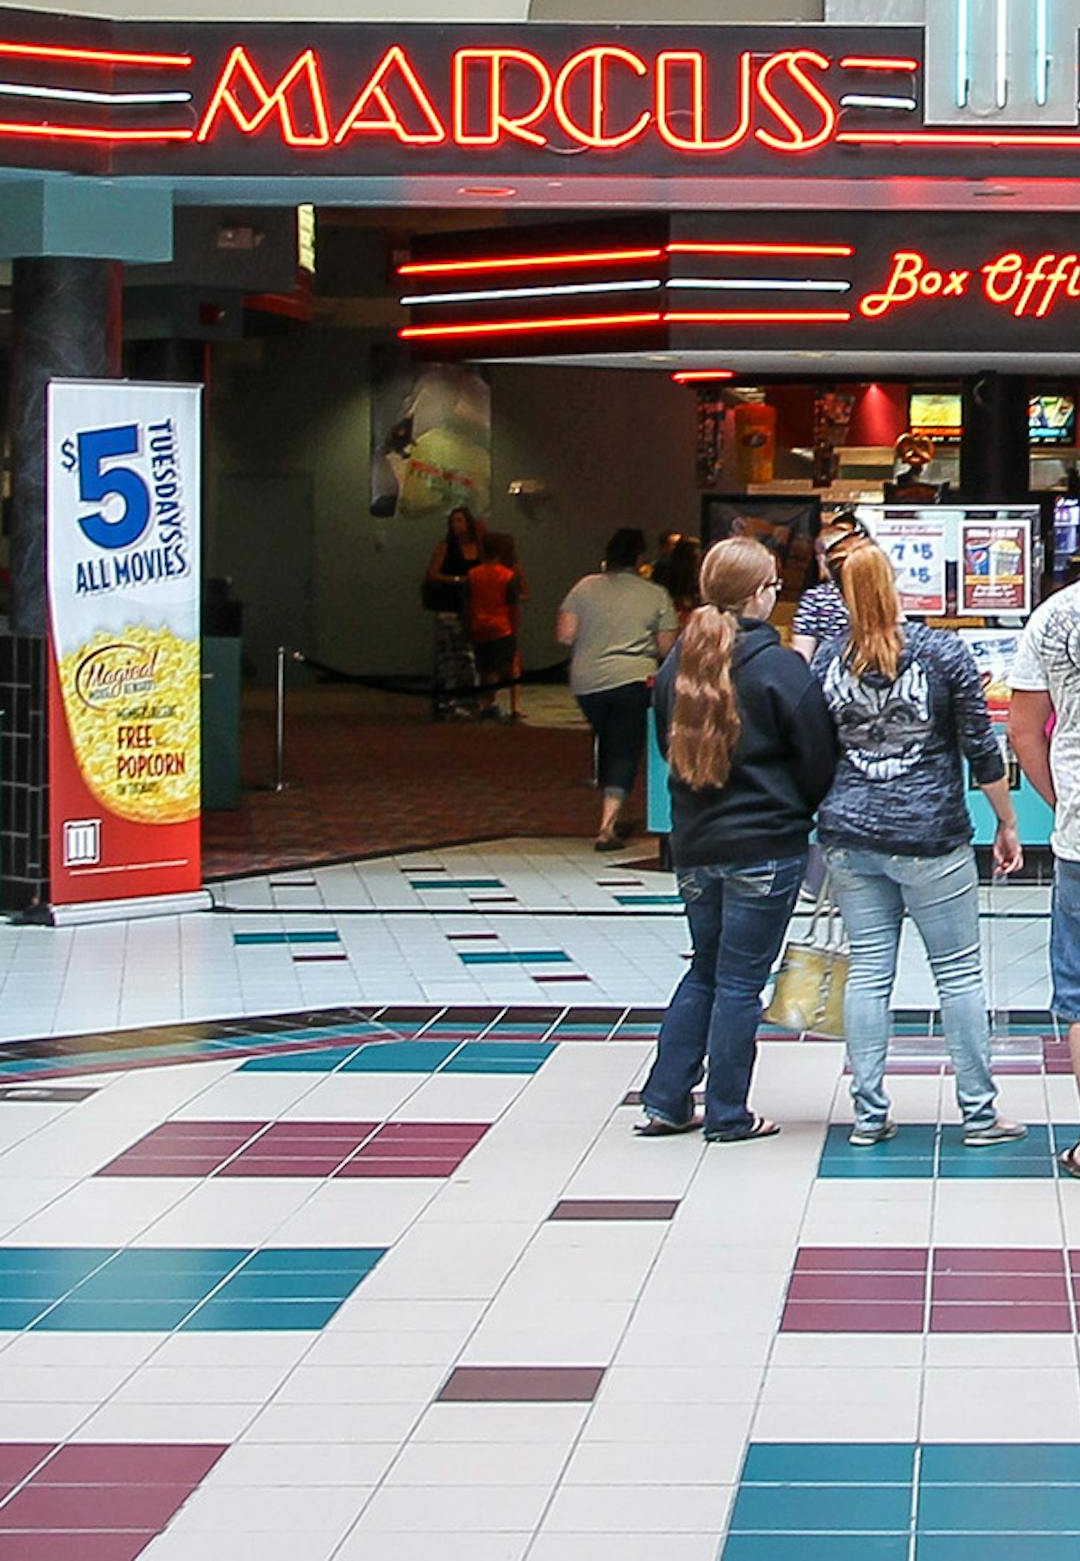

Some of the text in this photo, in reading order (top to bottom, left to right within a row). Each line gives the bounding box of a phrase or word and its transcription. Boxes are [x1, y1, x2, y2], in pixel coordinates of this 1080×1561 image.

[196, 44, 838, 153] MARCUS
[857, 251, 971, 318] Box
[61, 423, 151, 550] $5
[149, 419, 183, 543] TUESDAYS
[76, 543, 186, 593] ALL MOVIES
[86, 649, 159, 694] Magical
[117, 752, 185, 780] POPCORN
[118, 725, 152, 750] FREE
